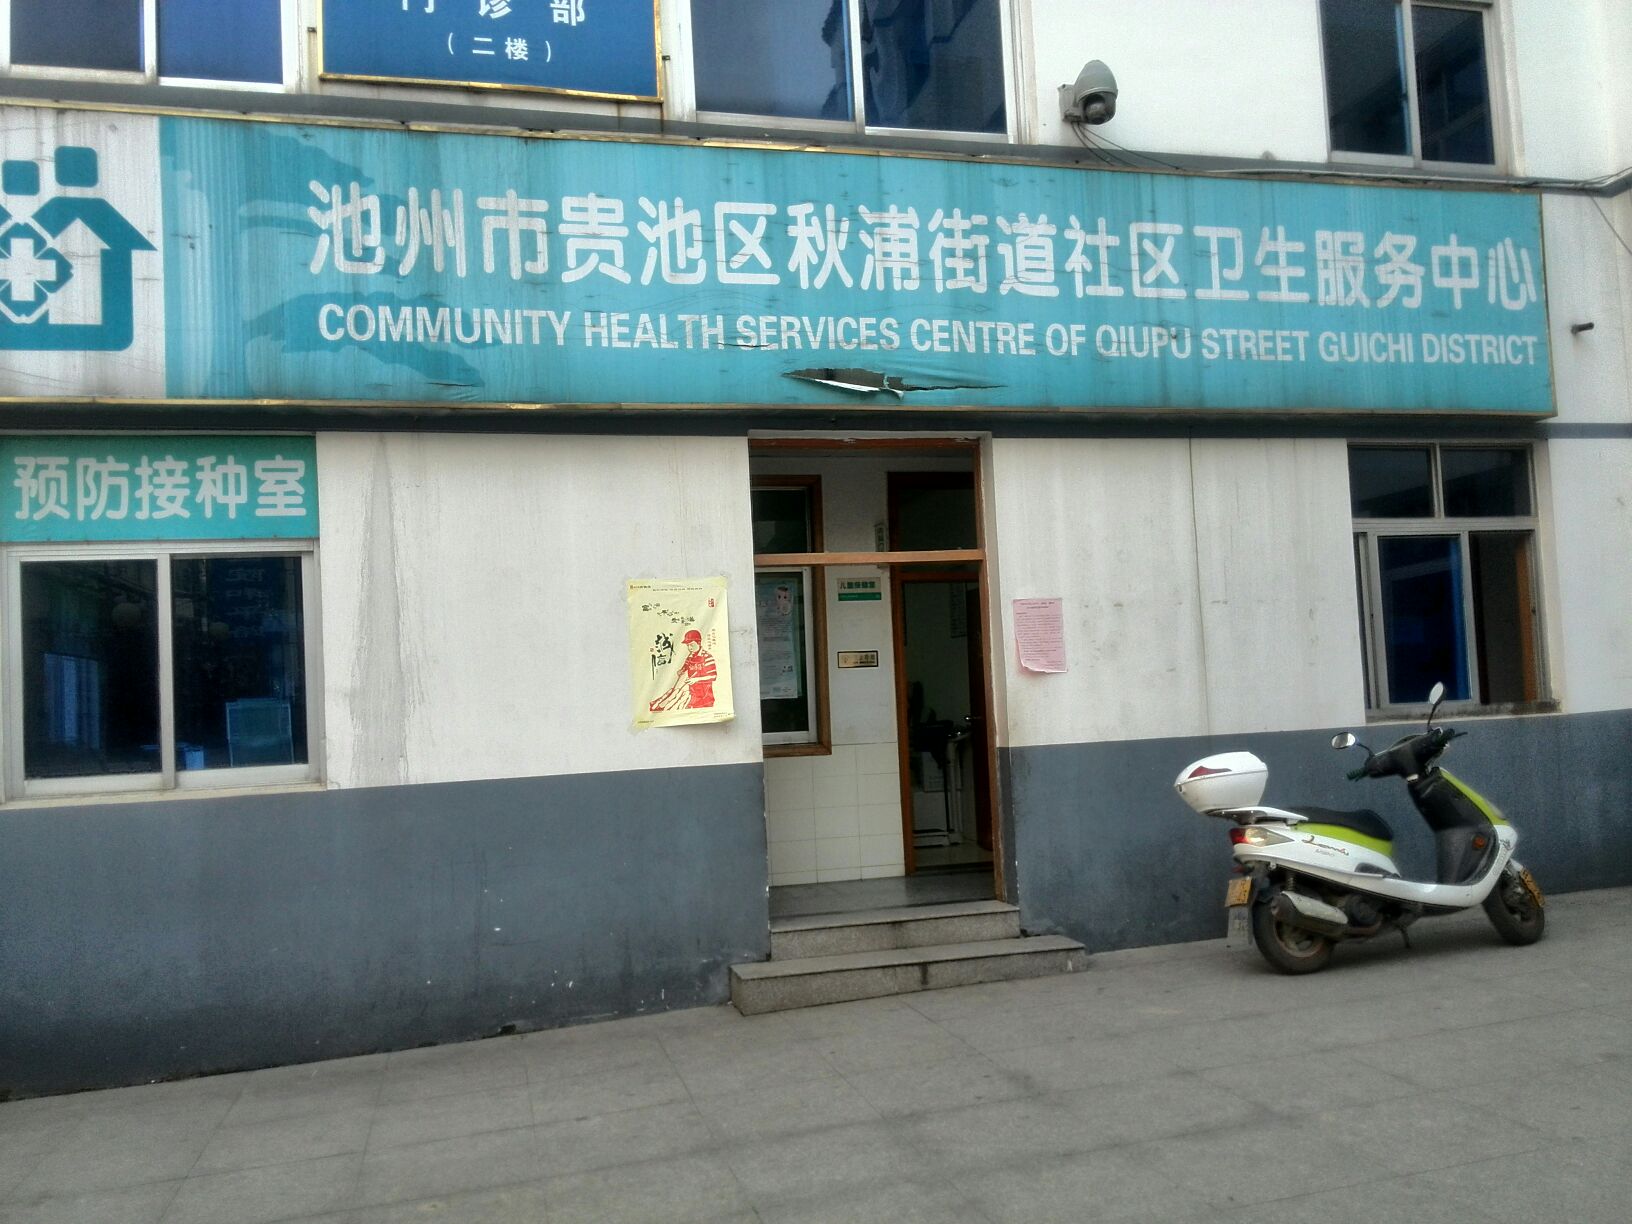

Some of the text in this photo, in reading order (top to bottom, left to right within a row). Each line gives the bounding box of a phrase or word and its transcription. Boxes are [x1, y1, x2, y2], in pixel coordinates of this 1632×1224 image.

[308, 179, 1537, 312] 池州市贵池区秋浦街道社区卫生服务中心
[318, 303, 1538, 367] COMMUNITY HEALTH SERVICES CENTRE OF QIUPU STREET GUICHI DISTRICT
[13, 453, 308, 522] 预防接种室
